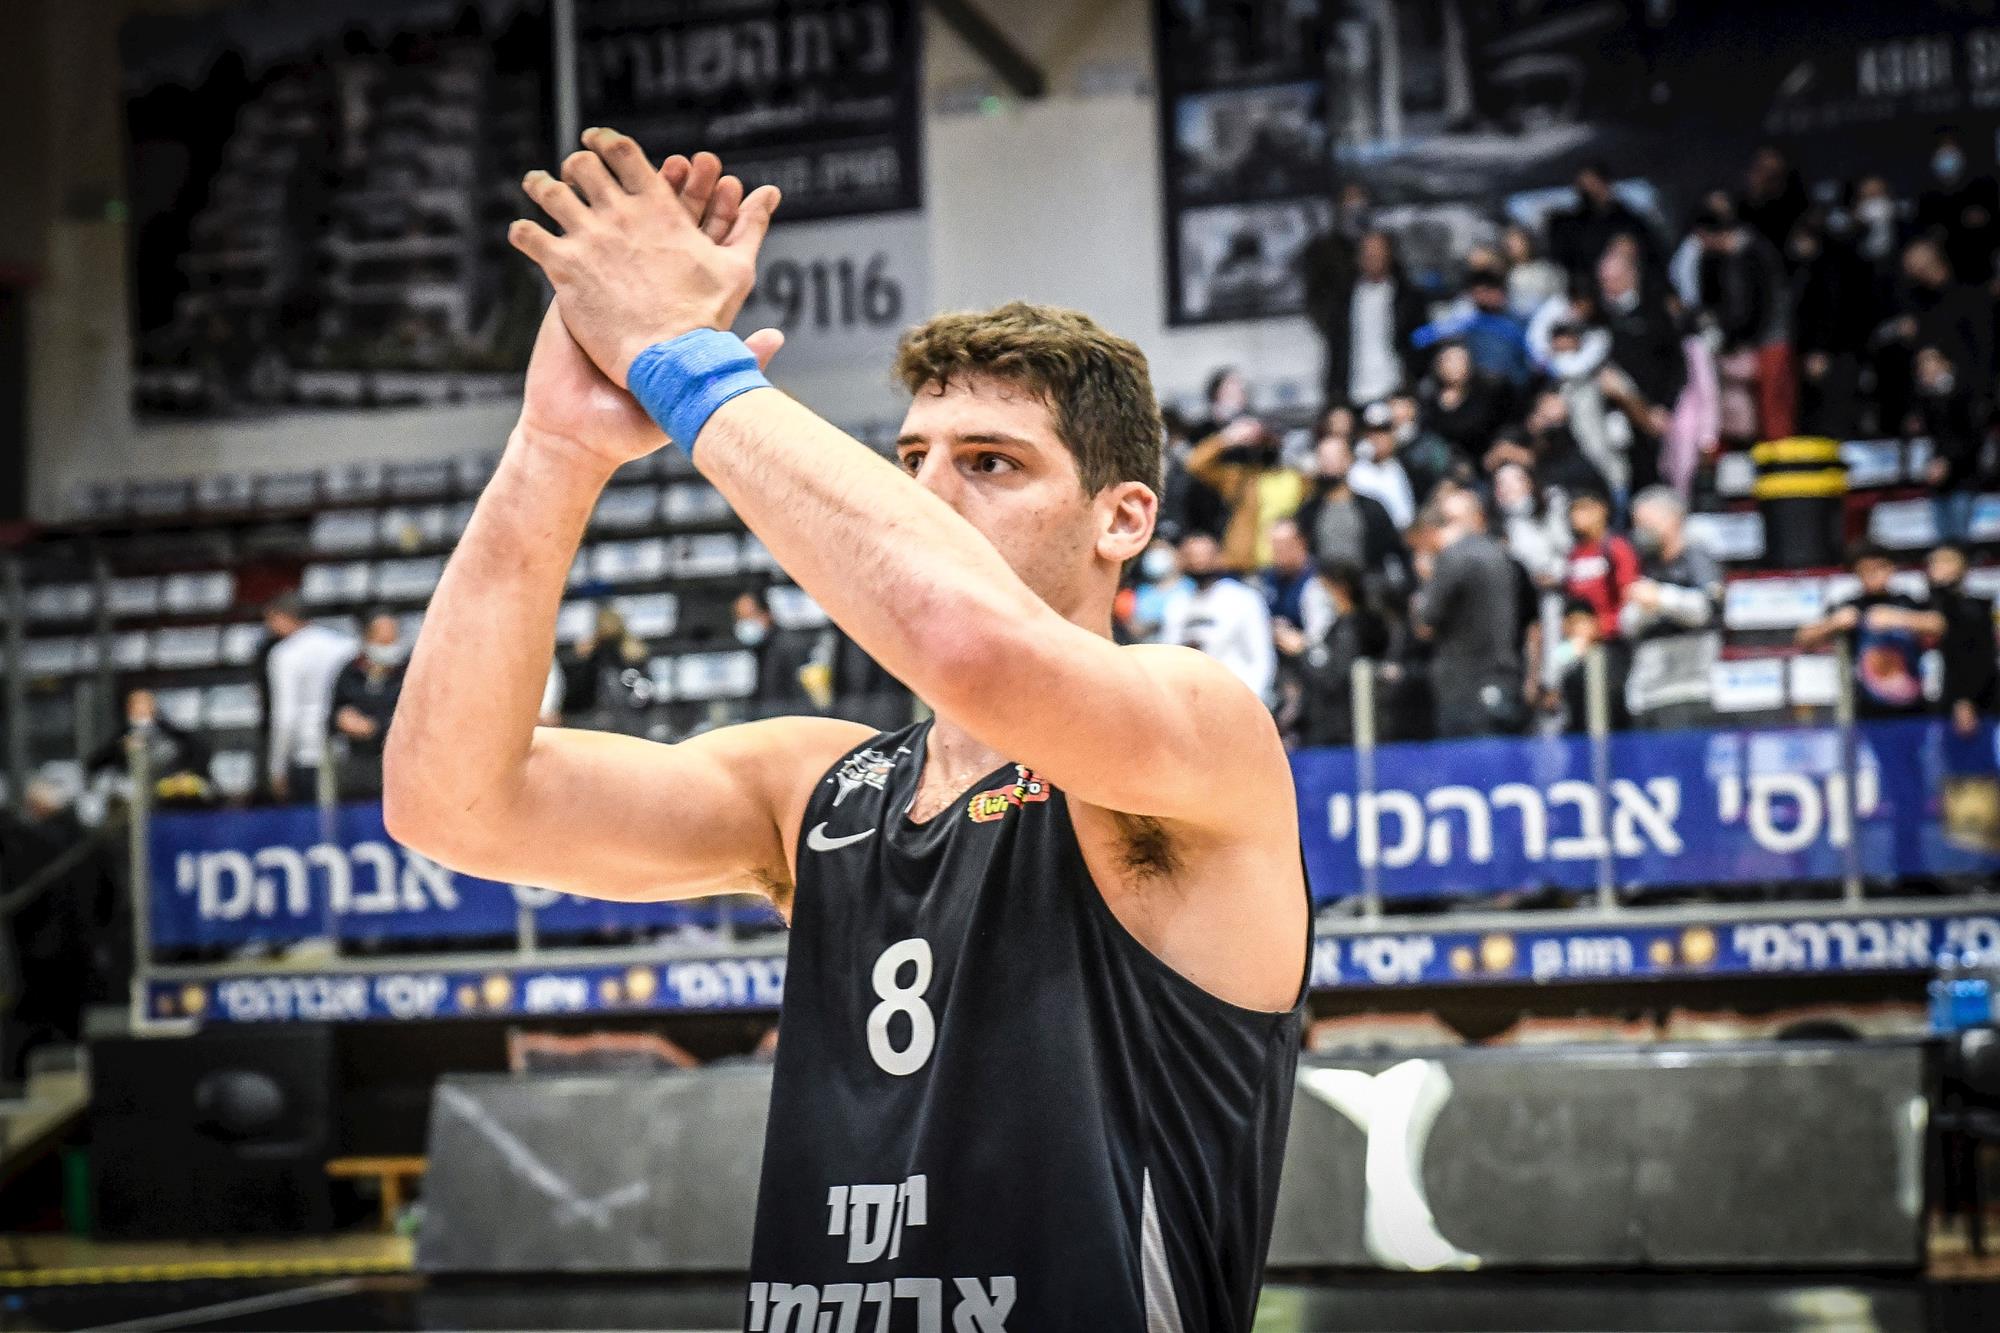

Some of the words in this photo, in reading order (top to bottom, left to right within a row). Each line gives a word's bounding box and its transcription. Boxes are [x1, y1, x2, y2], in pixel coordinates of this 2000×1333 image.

[1328, 777, 1683, 869] אברהמי
[1719, 768, 1879, 854] יוסי
[176, 841, 459, 922] אברהמי
[1733, 919, 1931, 972] אברהמי
[866, 938, 936, 1077] 8
[827, 1174, 928, 1264] יוסי
